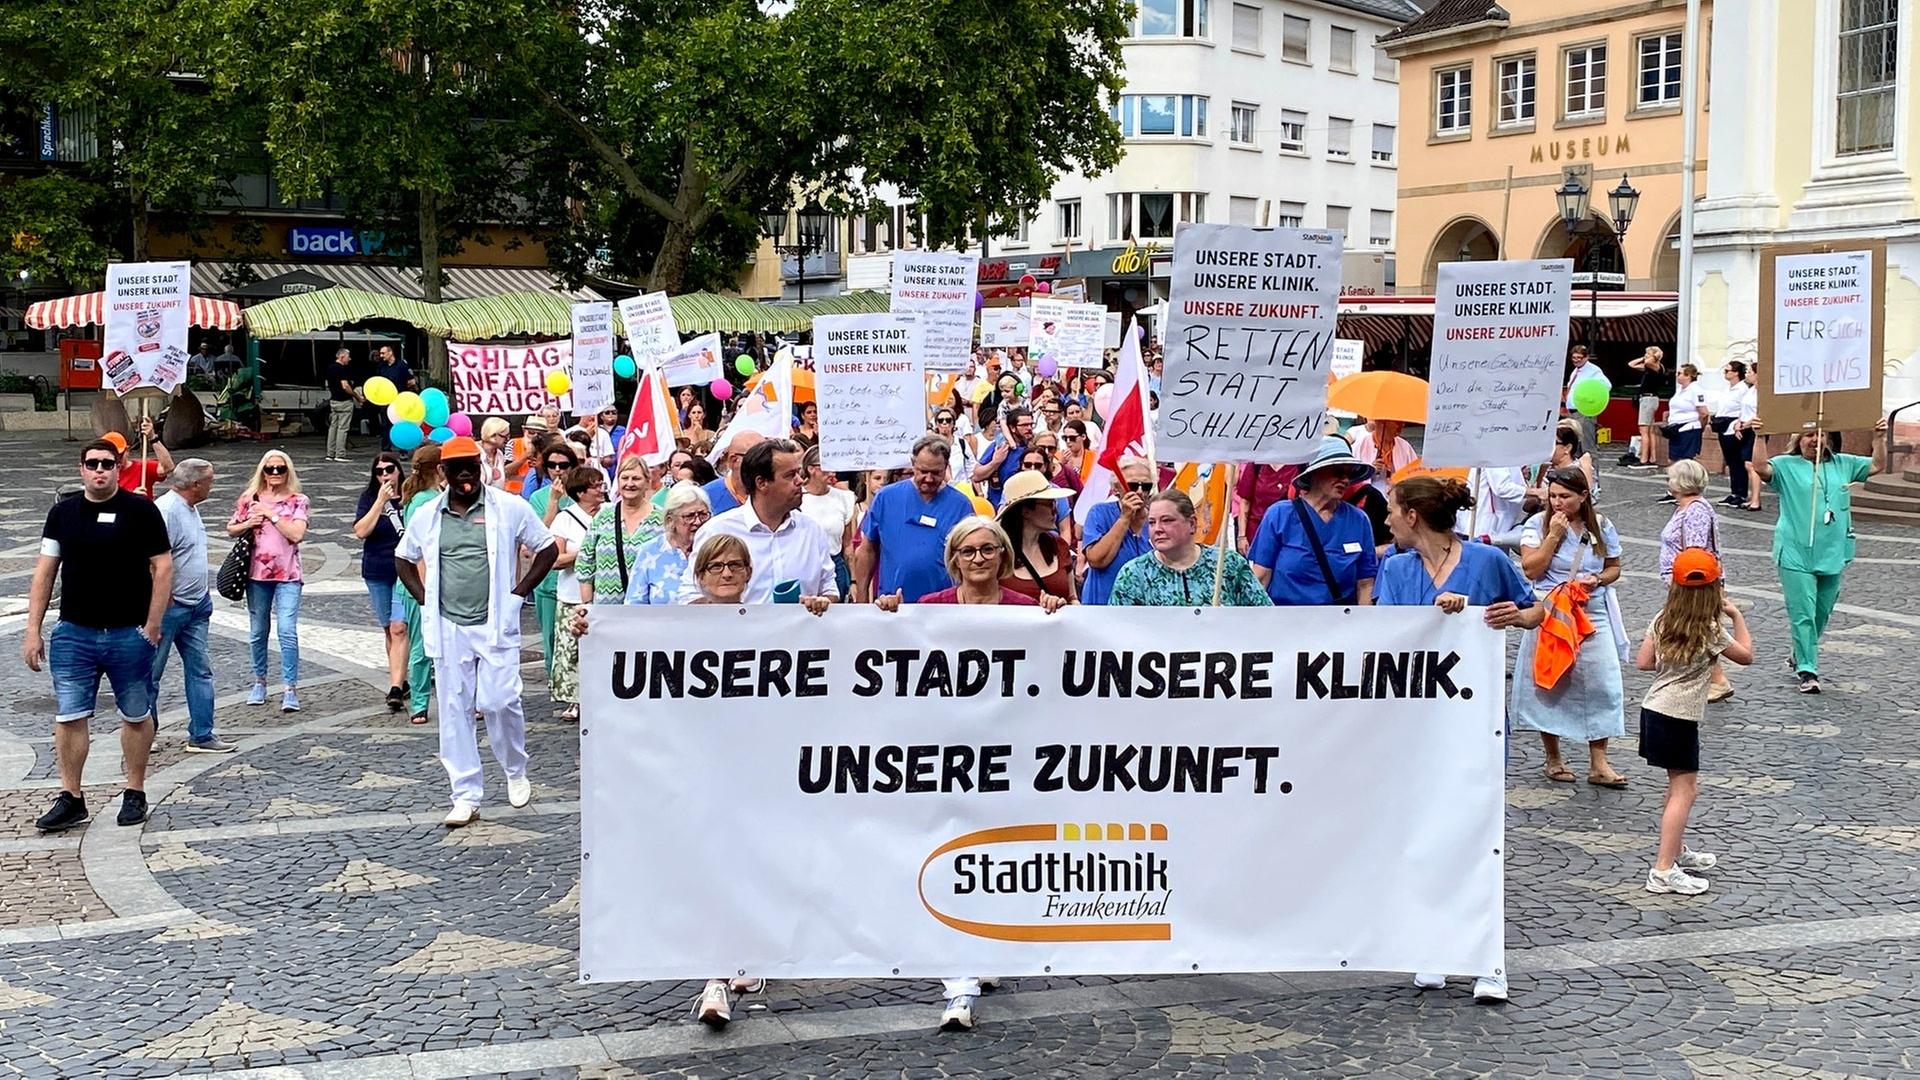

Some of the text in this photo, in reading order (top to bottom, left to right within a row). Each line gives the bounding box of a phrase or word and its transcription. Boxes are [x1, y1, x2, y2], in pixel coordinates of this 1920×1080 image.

[1530, 134, 1631, 163] MUSEUM
[1196, 250, 1322, 269] UNSERE STADT.
[904, 264, 936, 274] UNSERE
[1789, 266, 1860, 278] UNSERE STADT.
[118, 276, 149, 285] UNSERE
[904, 276, 967, 286] UNSERE KLINIK.
[1194, 273, 1319, 292] UNSERE KLINIK.
[1789, 279, 1860, 291] UNSERE KLINIK.
[118, 288, 149, 297] UNSERE
[899, 290, 929, 299] UNSERE
[1456, 281, 1557, 297] UNSERE STADT.
[113, 301, 144, 311] UNSERE
[1454, 301, 1554, 316] UNSERE KLINIK.
[1784, 295, 1863, 307] UNSERE ZUKUNFT.
[1184, 301, 1324, 319] UNSERE ZUKUNFT.
[828, 329, 911, 342] UNSERE STADT.
[1446, 325, 1559, 340] UNSERE ZUKUNFT.
[828, 344, 910, 356] UNSERE KLINIK.
[1183, 324, 1334, 371] RETTEN
[824, 362, 915, 373] UNSERE ZUKUNFT.
[1823, 357, 1862, 384] UNS
[1173, 371, 1298, 406] STATT
[611, 648, 1474, 701] UNSERE STADT. UNSERE KLINIK.
[799, 744, 1293, 794] UNSERE ZUKUNFT.
[953, 852, 1168, 895] Stadtklinik
[1042, 889, 1172, 920] Frankenthal
